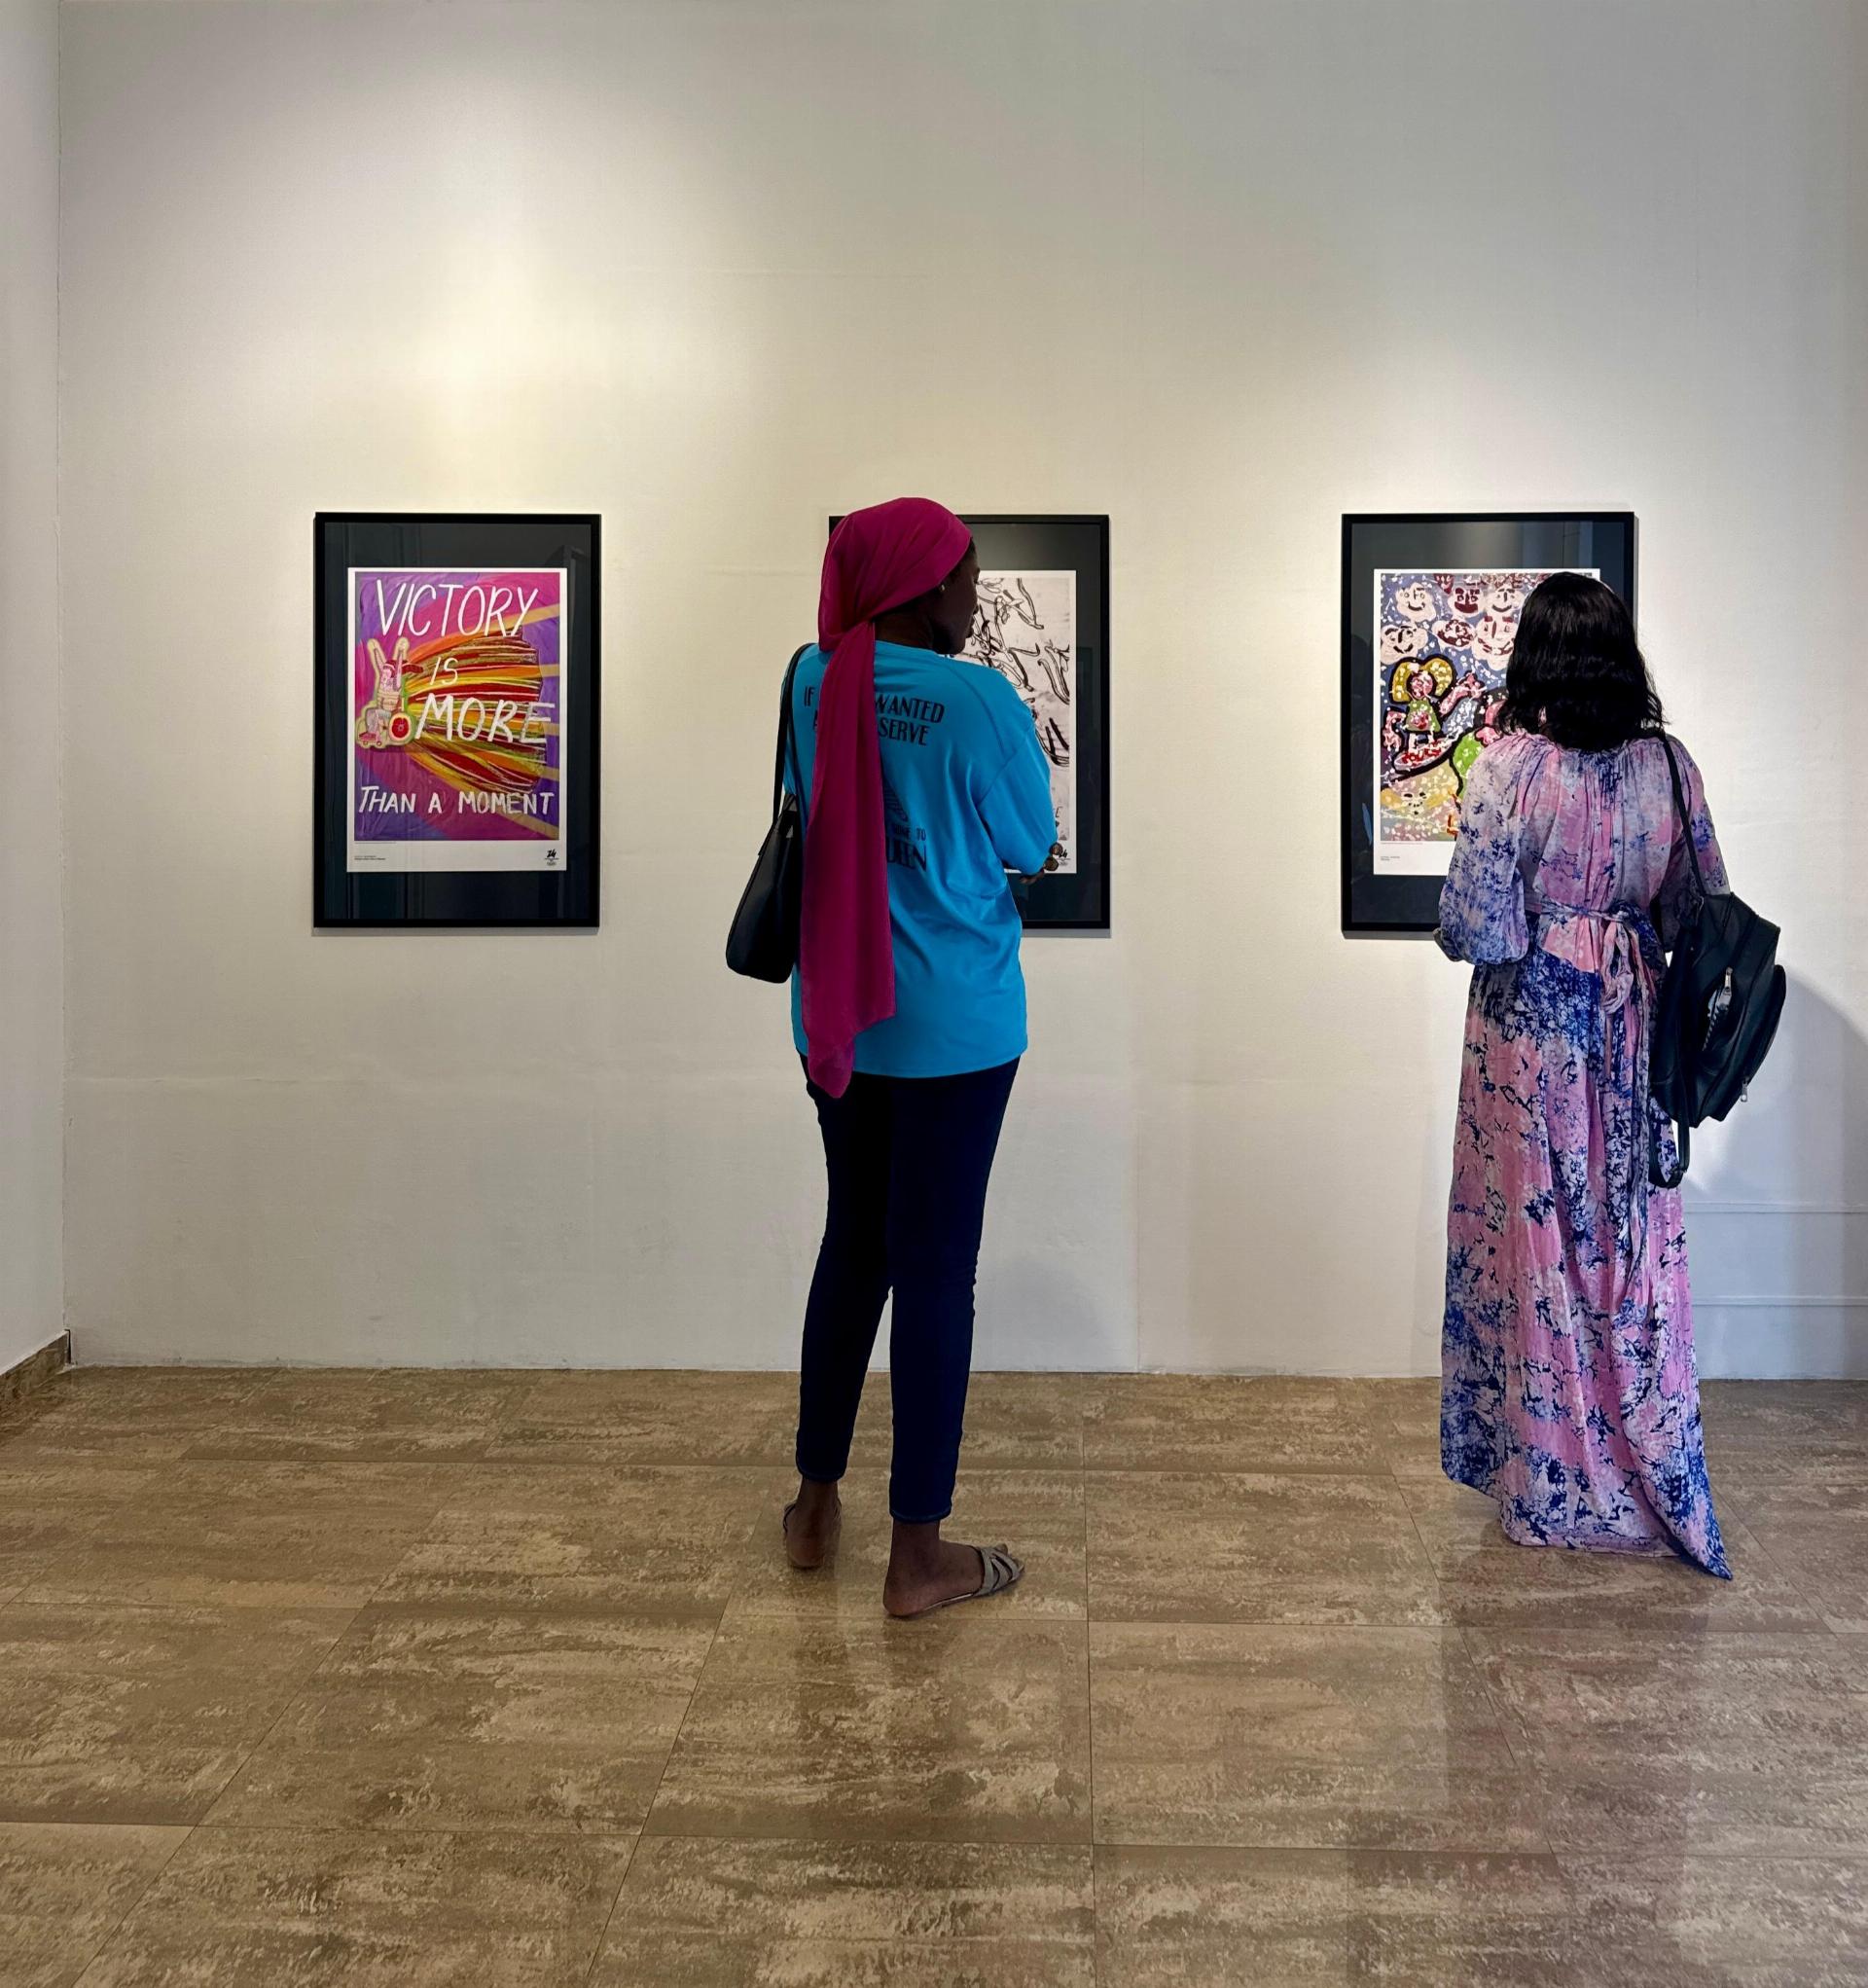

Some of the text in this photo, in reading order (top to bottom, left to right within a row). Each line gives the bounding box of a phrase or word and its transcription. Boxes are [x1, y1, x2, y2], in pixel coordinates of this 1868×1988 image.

[377, 579, 538, 636] VICTORY
[429, 657, 458, 686] IS
[415, 692, 556, 743] MORE
[804, 686, 945, 723] IF WANTED
[358, 785, 555, 813] THAN A MOMENT
